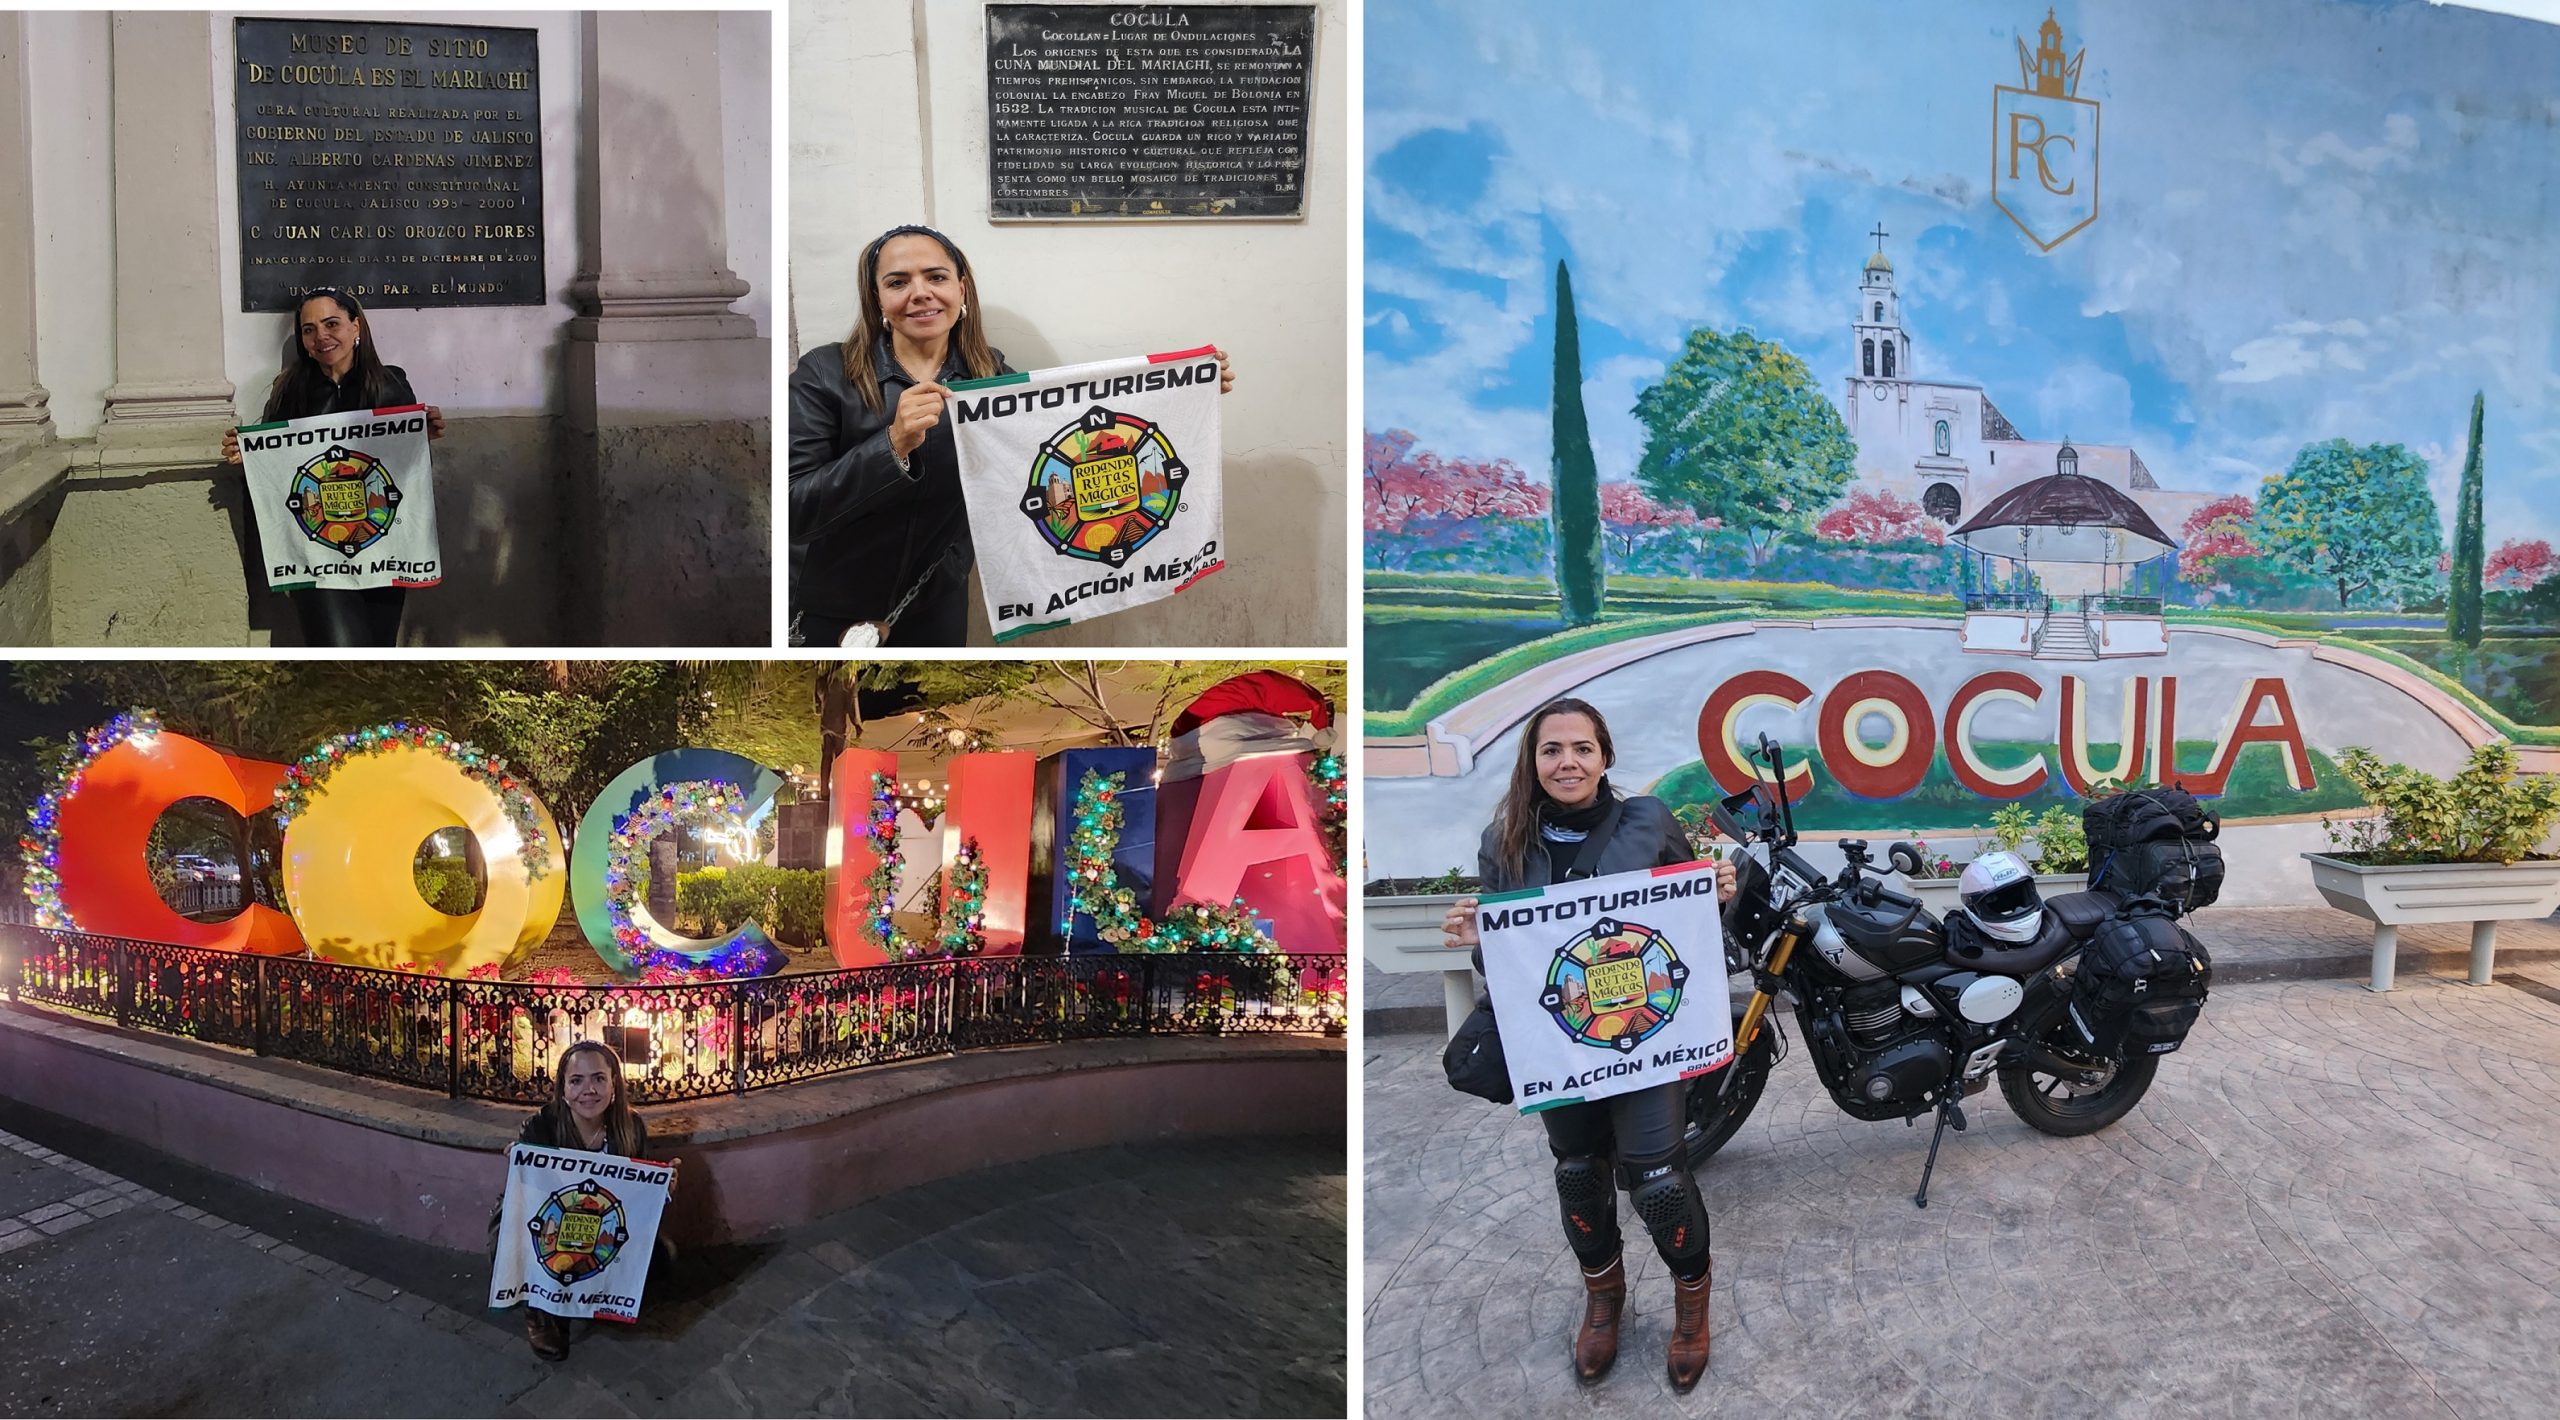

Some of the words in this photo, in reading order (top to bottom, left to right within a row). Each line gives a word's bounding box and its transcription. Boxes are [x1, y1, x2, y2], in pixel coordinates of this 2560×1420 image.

[1111, 13, 1189, 26] COCULA
[1154, 33, 1167, 41] DE
[1171, 31, 1256, 41] ONDULACIONES
[291, 33, 367, 54] MUSEO
[385, 37, 413, 55] DE
[429, 38, 488, 58] SITIO
[1013, 44, 1037, 56] LOS
[1205, 48, 1279, 56] CONSIDERADA
[995, 60, 1032, 70] CUNA
[1038, 60, 1100, 70] MUNDIAL
[1108, 60, 1135, 70] DEL
[281, 65, 365, 86] COCULA
[371, 68, 395, 86] ES
[401, 69, 426, 87] EL
[1135, 90, 1160, 99] FRAY
[1168, 89, 1207, 99] MIGUEL
[257, 105, 296, 115] OBRA
[305, 106, 380, 117] CULTURAL
[388, 108, 468, 119] REALIZADA
[476, 111, 498, 120] POR
[507, 111, 522, 121] EL
[1038, 104, 1054, 114] LA
[1194, 104, 1236, 113] COCULA
[247, 126, 326, 141] GOBIERNO
[335, 128, 364, 141] DEL
[375, 130, 435, 142] ESTADO
[444, 131, 464, 143] DE
[472, 131, 534, 145] JALISCO
[1093, 131, 1134, 141] COCULA
[1248, 133, 1297, 141] VARIADO
[248, 152, 277, 165] ING.
[289, 153, 362, 165] ALBERTO
[372, 153, 455, 167] CARDENAS
[465, 154, 533, 168] JIMENEZ
[287, 180, 399, 190] AYUNTAMIENTO
[408, 181, 519, 191] CONSTITUCIONAL
[998, 189, 1069, 197] COSTUMBRES
[272, 199, 287, 208] DE
[361, 199, 419, 208] JALISCO
[480, 199, 514, 208] 2000
[274, 225, 320, 239] JUAN
[330, 225, 396, 239] CARLOS
[405, 225, 466, 238] OROZCO
[474, 225, 535, 238] FLORES
[432, 284, 447, 294] EL
[958, 363, 1217, 424] MOTOTURISMO
[1090, 412, 1107, 426] N
[243, 417, 424, 452] MOTOTURISMO
[1170, 467, 1182, 479] E
[1026, 496, 1042, 510] O
[1110, 549, 1123, 561] S
[274, 564, 296, 578] EN
[304, 560, 363, 576] ACCIÓN
[371, 556, 436, 574] MÉXICO
[998, 603, 1033, 621] EN
[1045, 572, 1134, 614] ACCIÓN
[1698, 670, 2315, 800] COCULA
[28, 728, 1347, 980] COCULA
[1482, 877, 1712, 932] MOTOTURISMO
[1599, 923, 1615, 934] N
[1672, 968, 1684, 978] E
[1544, 994, 1559, 1005] O
[1620, 1038, 1632, 1048] S
[1523, 1081, 1552, 1097] EN
[1563, 1058, 1643, 1091] ACCIÓN
[1653, 1039, 1728, 1068] MÉXICO
[514, 1150, 669, 1186] MOTOTURISMO
[496, 1288, 516, 1301] EN
[519, 1282, 573, 1303] ACCIÓN
[578, 1291, 636, 1308] MÉXICO
